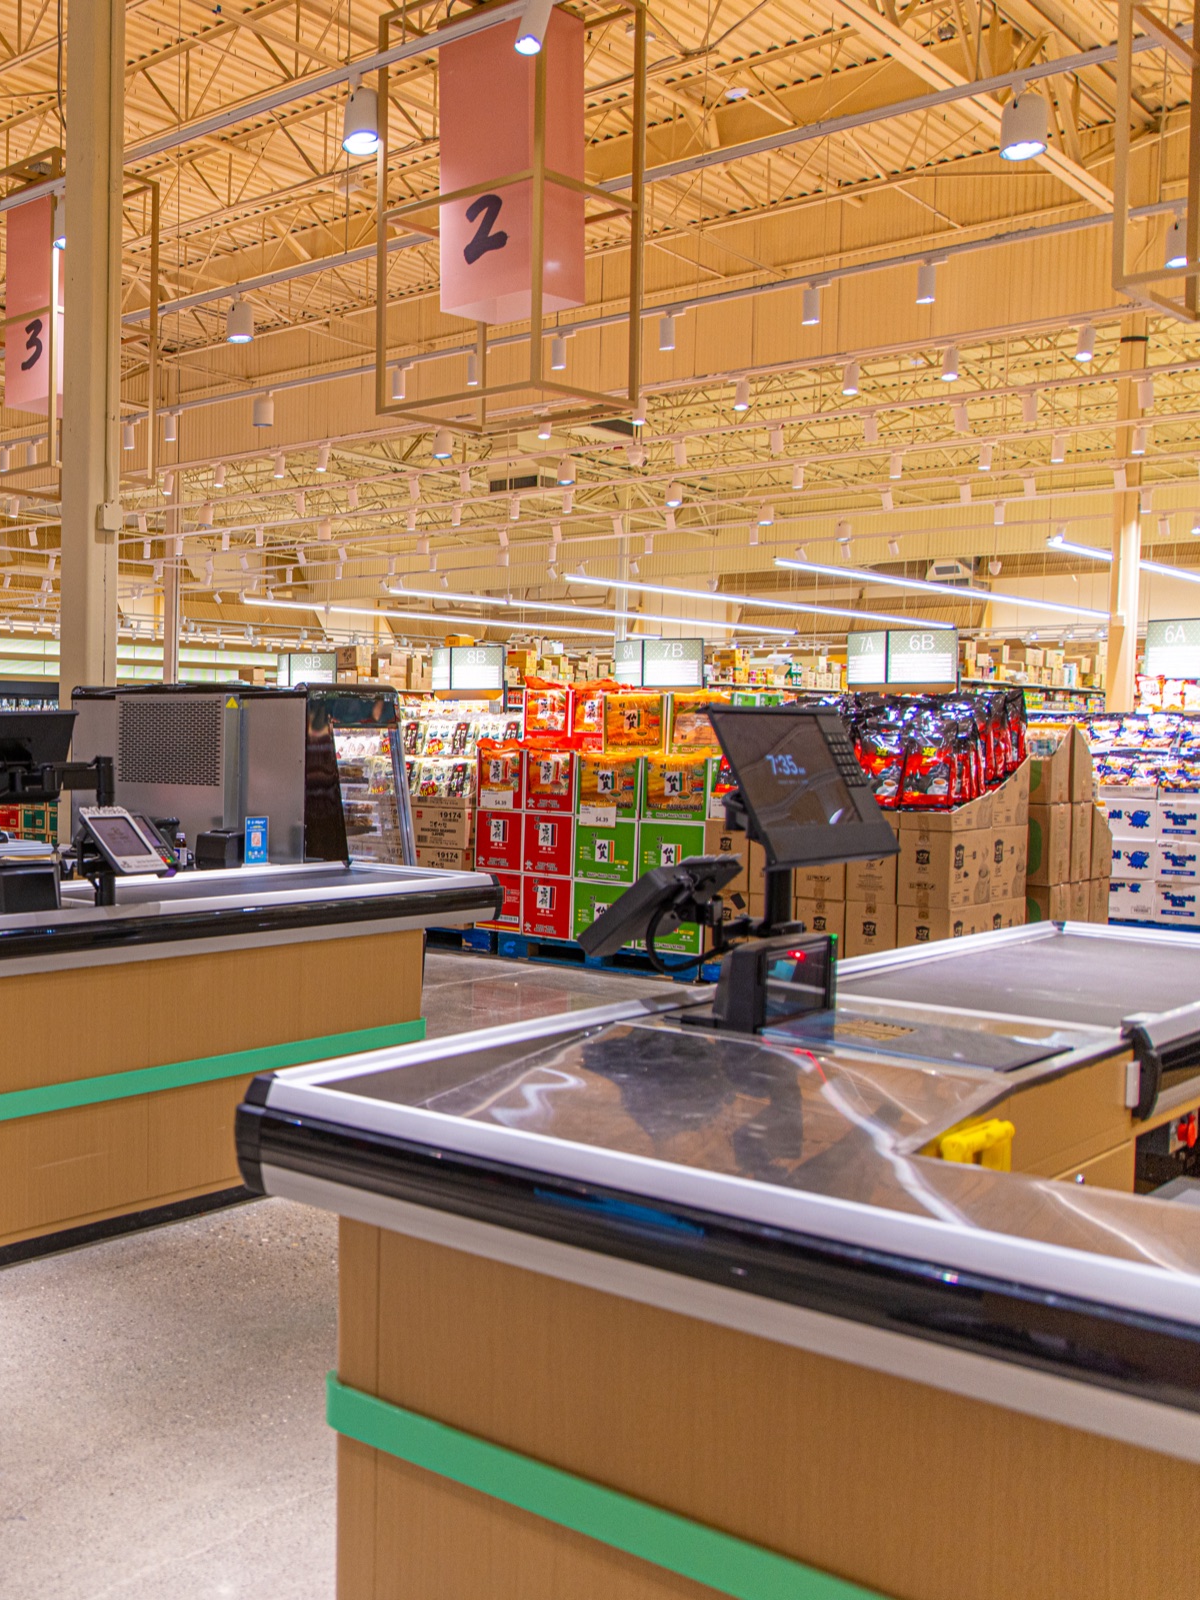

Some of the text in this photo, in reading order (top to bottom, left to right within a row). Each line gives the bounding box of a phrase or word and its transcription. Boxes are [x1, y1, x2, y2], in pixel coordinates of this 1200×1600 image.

[463, 194, 509, 265] 2
[21, 318, 43, 371] 3
[909, 634, 935, 650] 6B
[1164, 625, 1186, 644] 6A
[623, 644, 634, 659] 8A
[662, 643, 684, 658] 7B
[859, 636, 874, 652] 7A
[304, 656, 321, 669] 9B
[467, 650, 486, 664] 8B
[765, 754, 798, 775] 7:35
[440, 811, 462, 819] 19174
[437, 851, 458, 859] 19174
